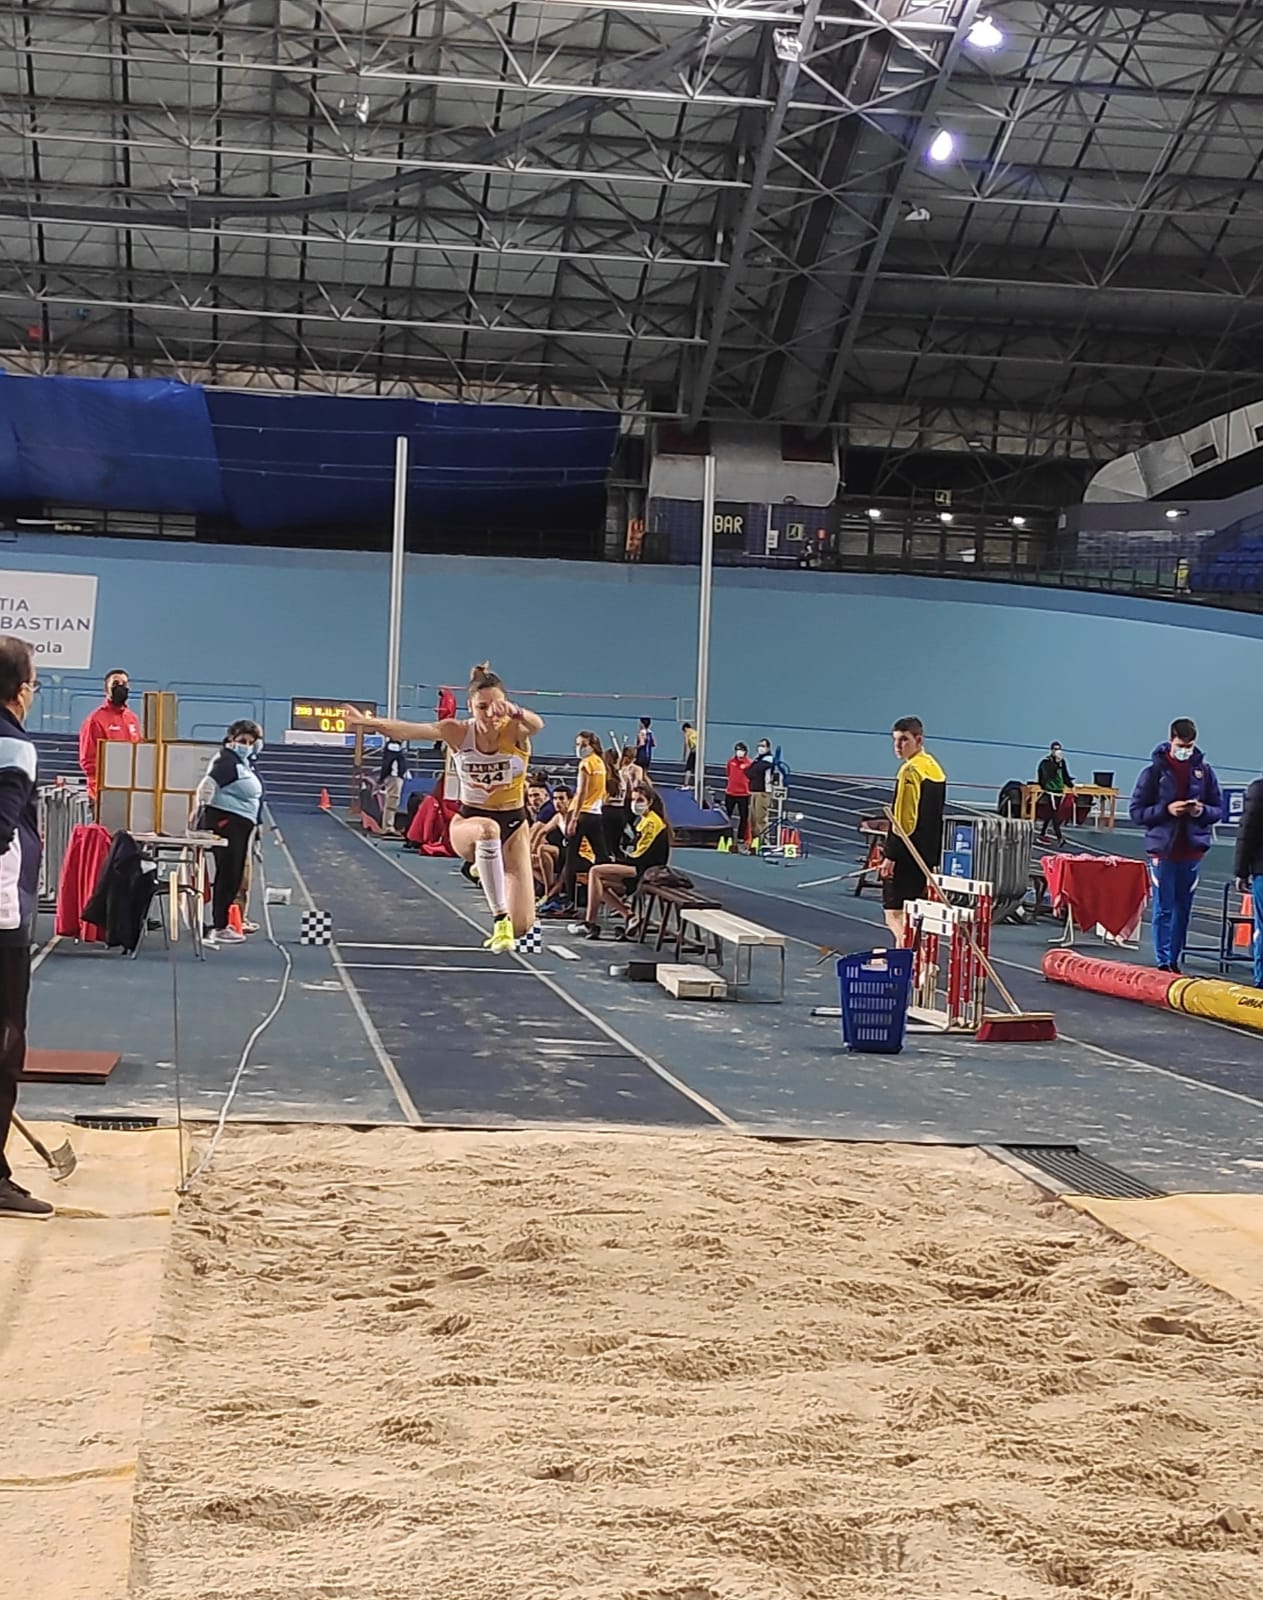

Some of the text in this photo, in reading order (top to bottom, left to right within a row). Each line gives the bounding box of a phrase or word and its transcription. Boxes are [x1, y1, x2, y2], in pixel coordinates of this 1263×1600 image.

[714, 515, 743, 534] BAR
[0, 617, 90, 631] BASTIAN
[320, 719, 345, 732] 0.0
